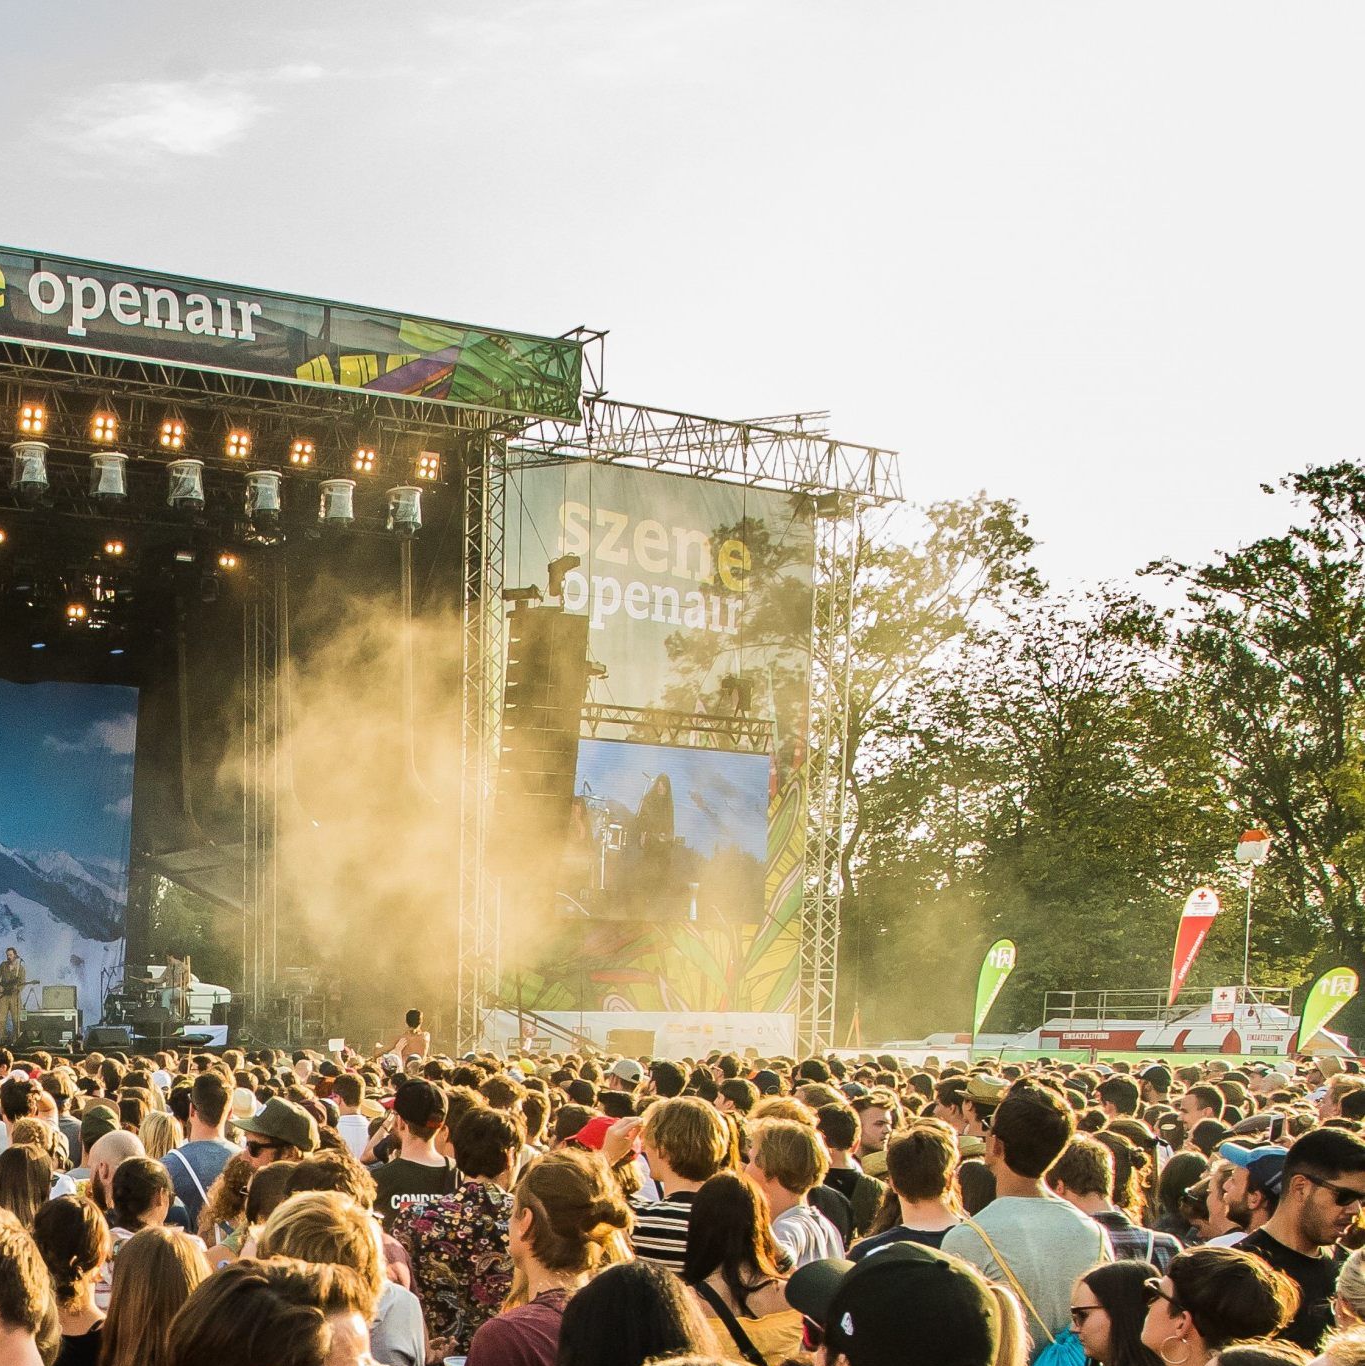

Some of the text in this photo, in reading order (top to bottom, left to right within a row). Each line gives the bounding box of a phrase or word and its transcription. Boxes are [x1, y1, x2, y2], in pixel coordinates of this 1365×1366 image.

[29, 269, 262, 341] openair
[557, 501, 752, 592] szene
[562, 570, 743, 635] openair
